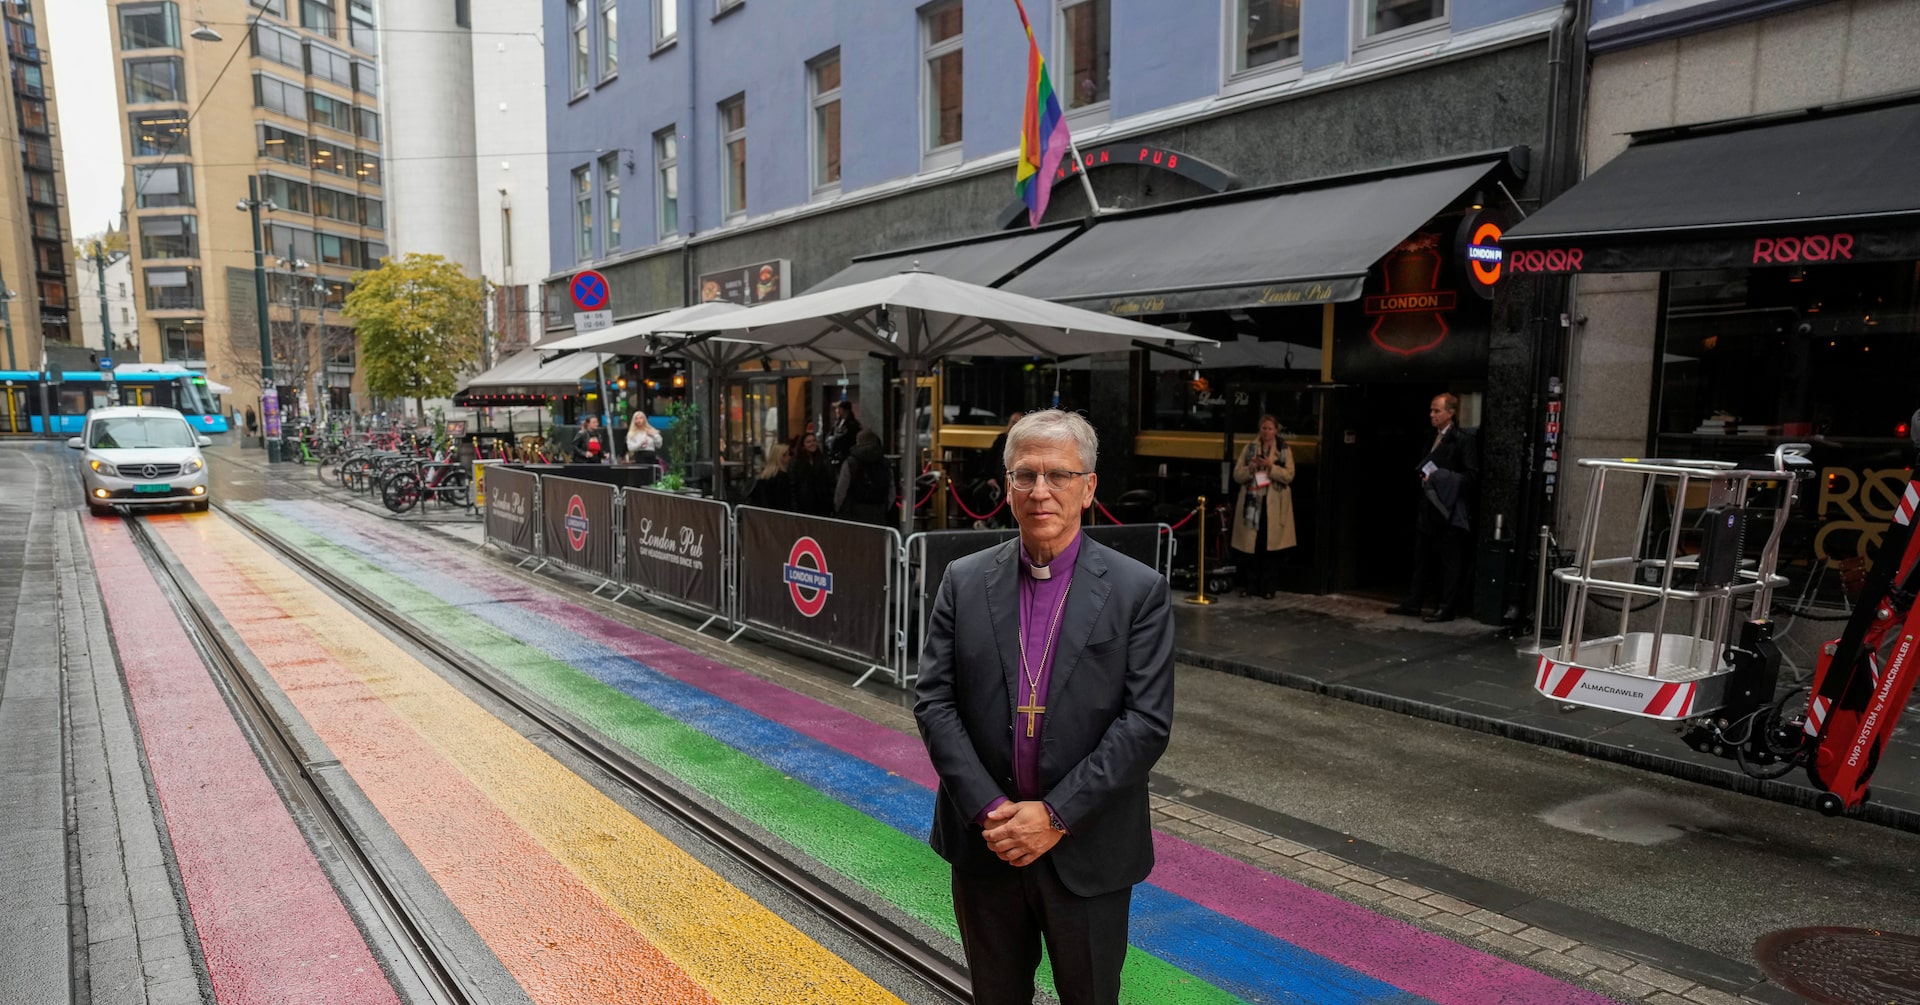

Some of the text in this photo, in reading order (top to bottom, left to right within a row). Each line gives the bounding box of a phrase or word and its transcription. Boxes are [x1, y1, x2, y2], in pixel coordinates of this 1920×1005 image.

[1139, 148, 1178, 168] PUB
[1469, 247, 1494, 260] LONDON
[1257, 282, 1335, 304] London Pub
[1380, 295, 1439, 310] LONDON
[639, 517, 703, 558] London Pub
[789, 569, 827, 587] LONDON PUB
[1580, 682, 1645, 699] ALMACRAWLER
[1847, 641, 1911, 767] DWP SYSTEM by ALMACRAWLER
